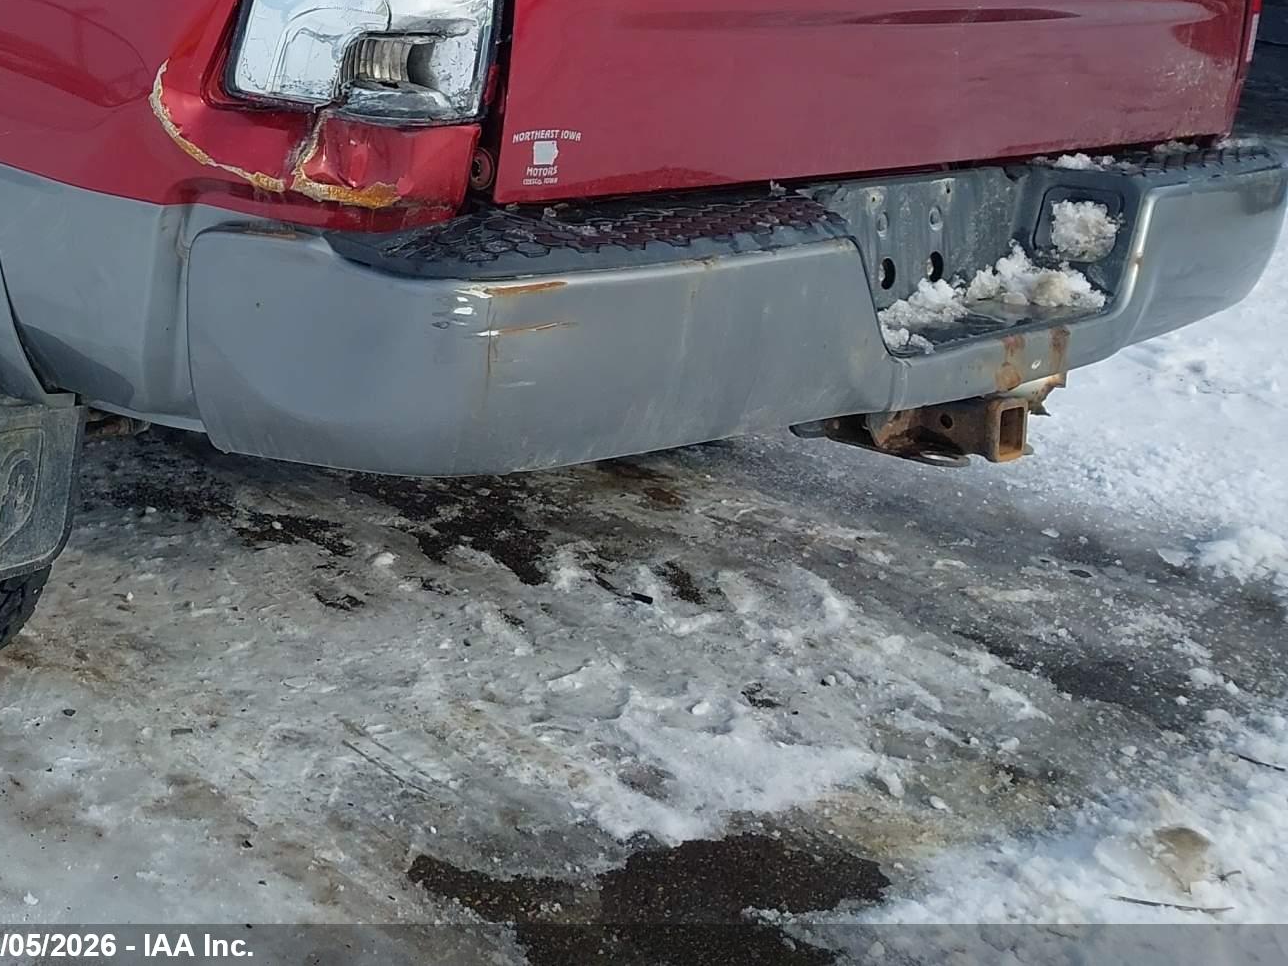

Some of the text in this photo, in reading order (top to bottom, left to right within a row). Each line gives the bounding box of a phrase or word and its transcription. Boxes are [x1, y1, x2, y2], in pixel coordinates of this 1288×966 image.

[512, 129, 582, 144] NORTHEAST IOWA
[526, 165, 558, 177] MOTORS
